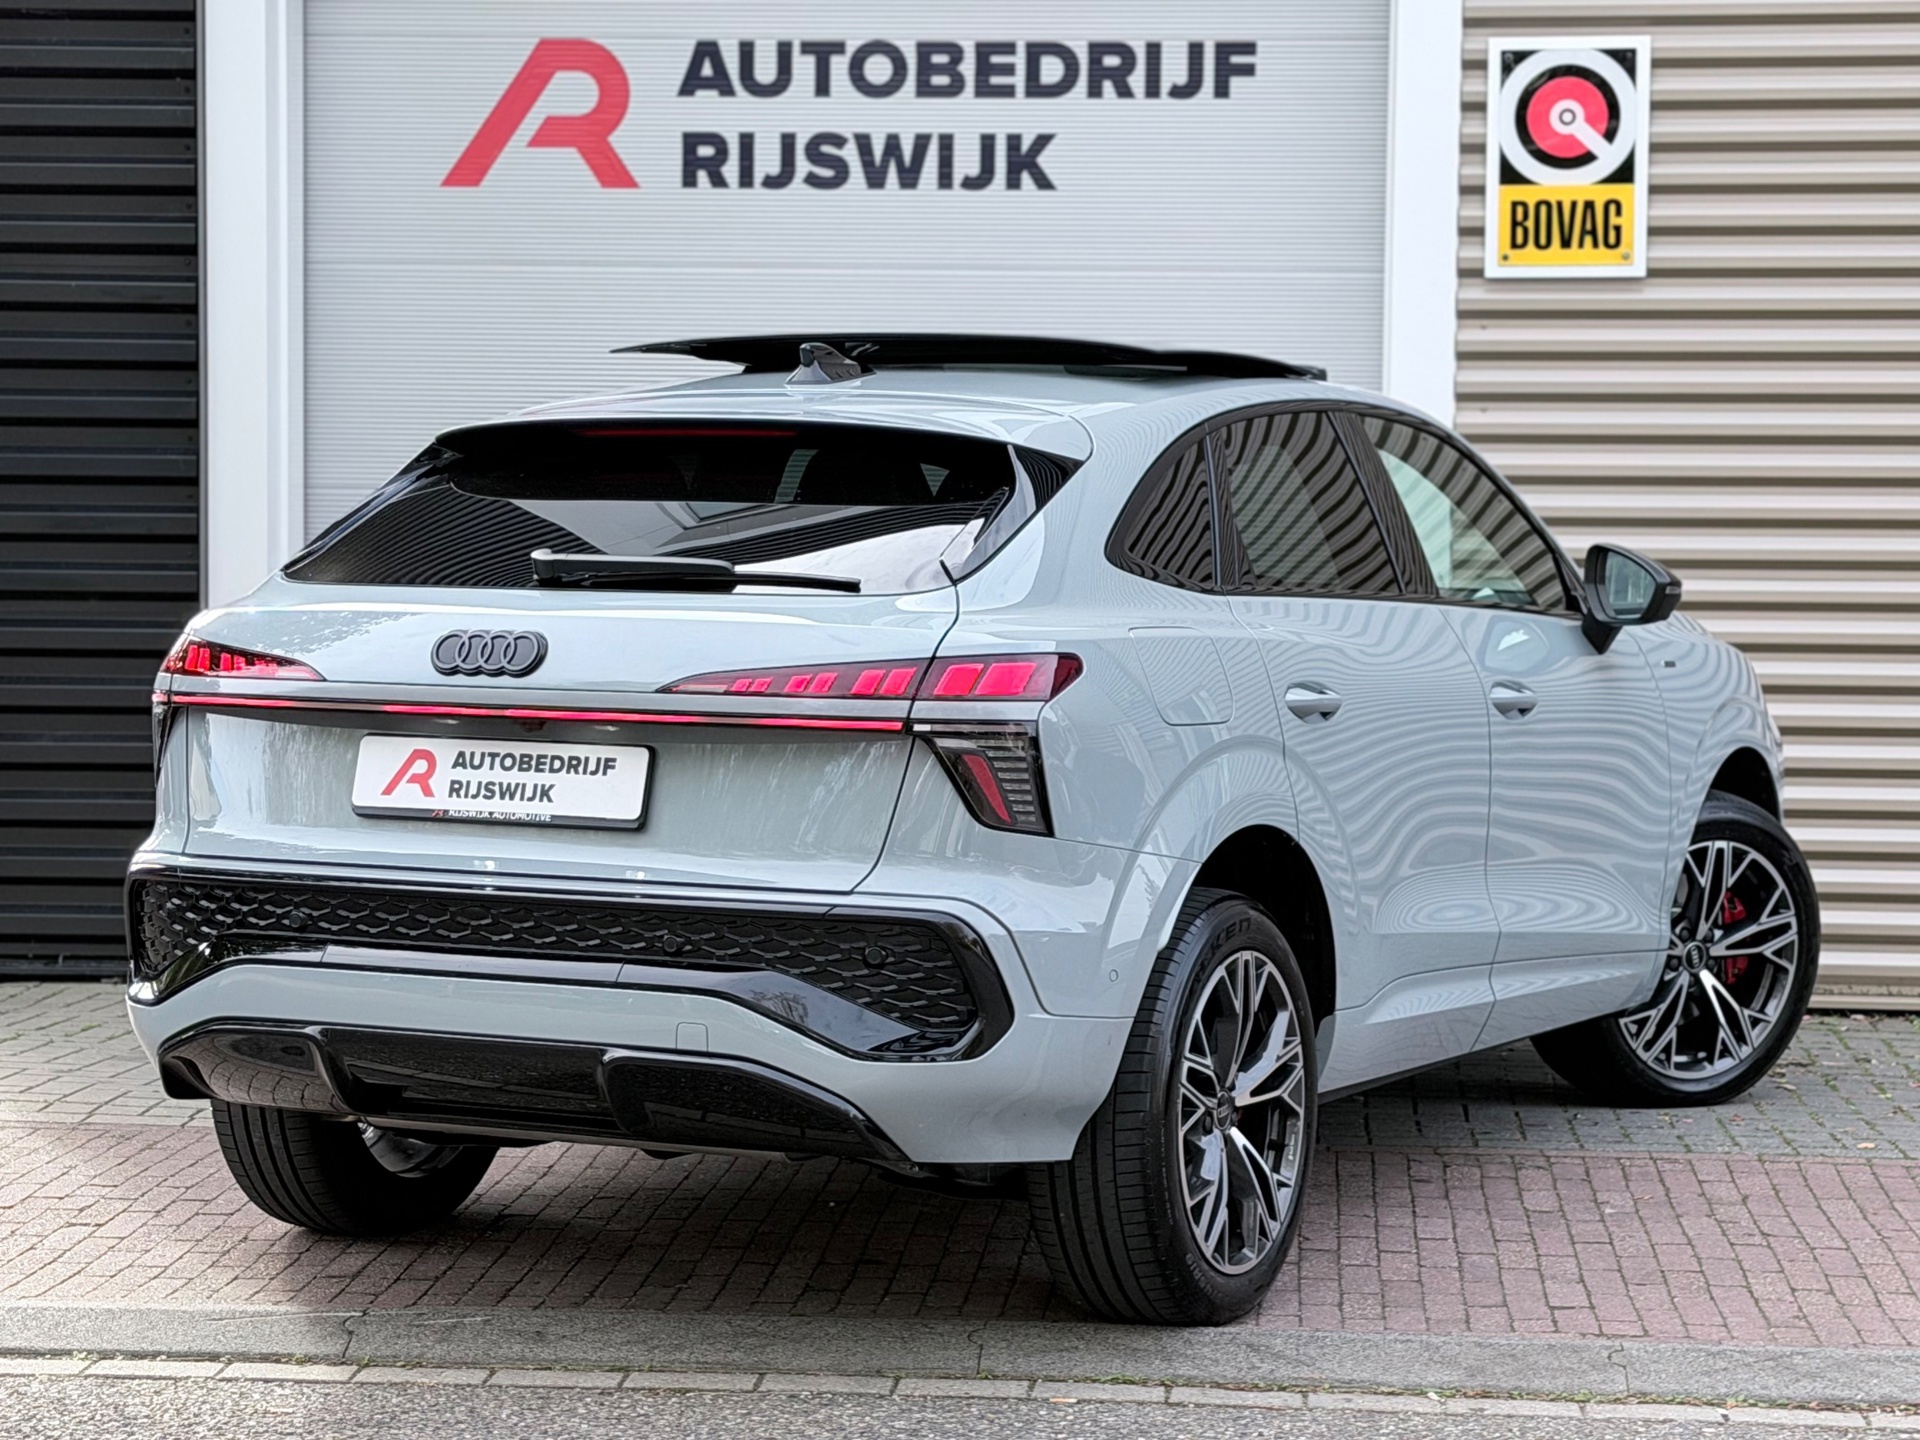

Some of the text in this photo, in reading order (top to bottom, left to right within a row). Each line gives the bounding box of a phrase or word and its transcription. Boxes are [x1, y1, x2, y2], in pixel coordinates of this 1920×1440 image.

[678, 40, 1257, 99] AUTOBEDRIJF
[682, 132, 1056, 191] RIJSWIJK
[1510, 199, 1622, 250] BOVAG
[451, 750, 617, 776] AUTOBEDRIJF
[448, 779, 556, 803] RIJSWIJK
[492, 811, 552, 822] AUTOMOTIVE
